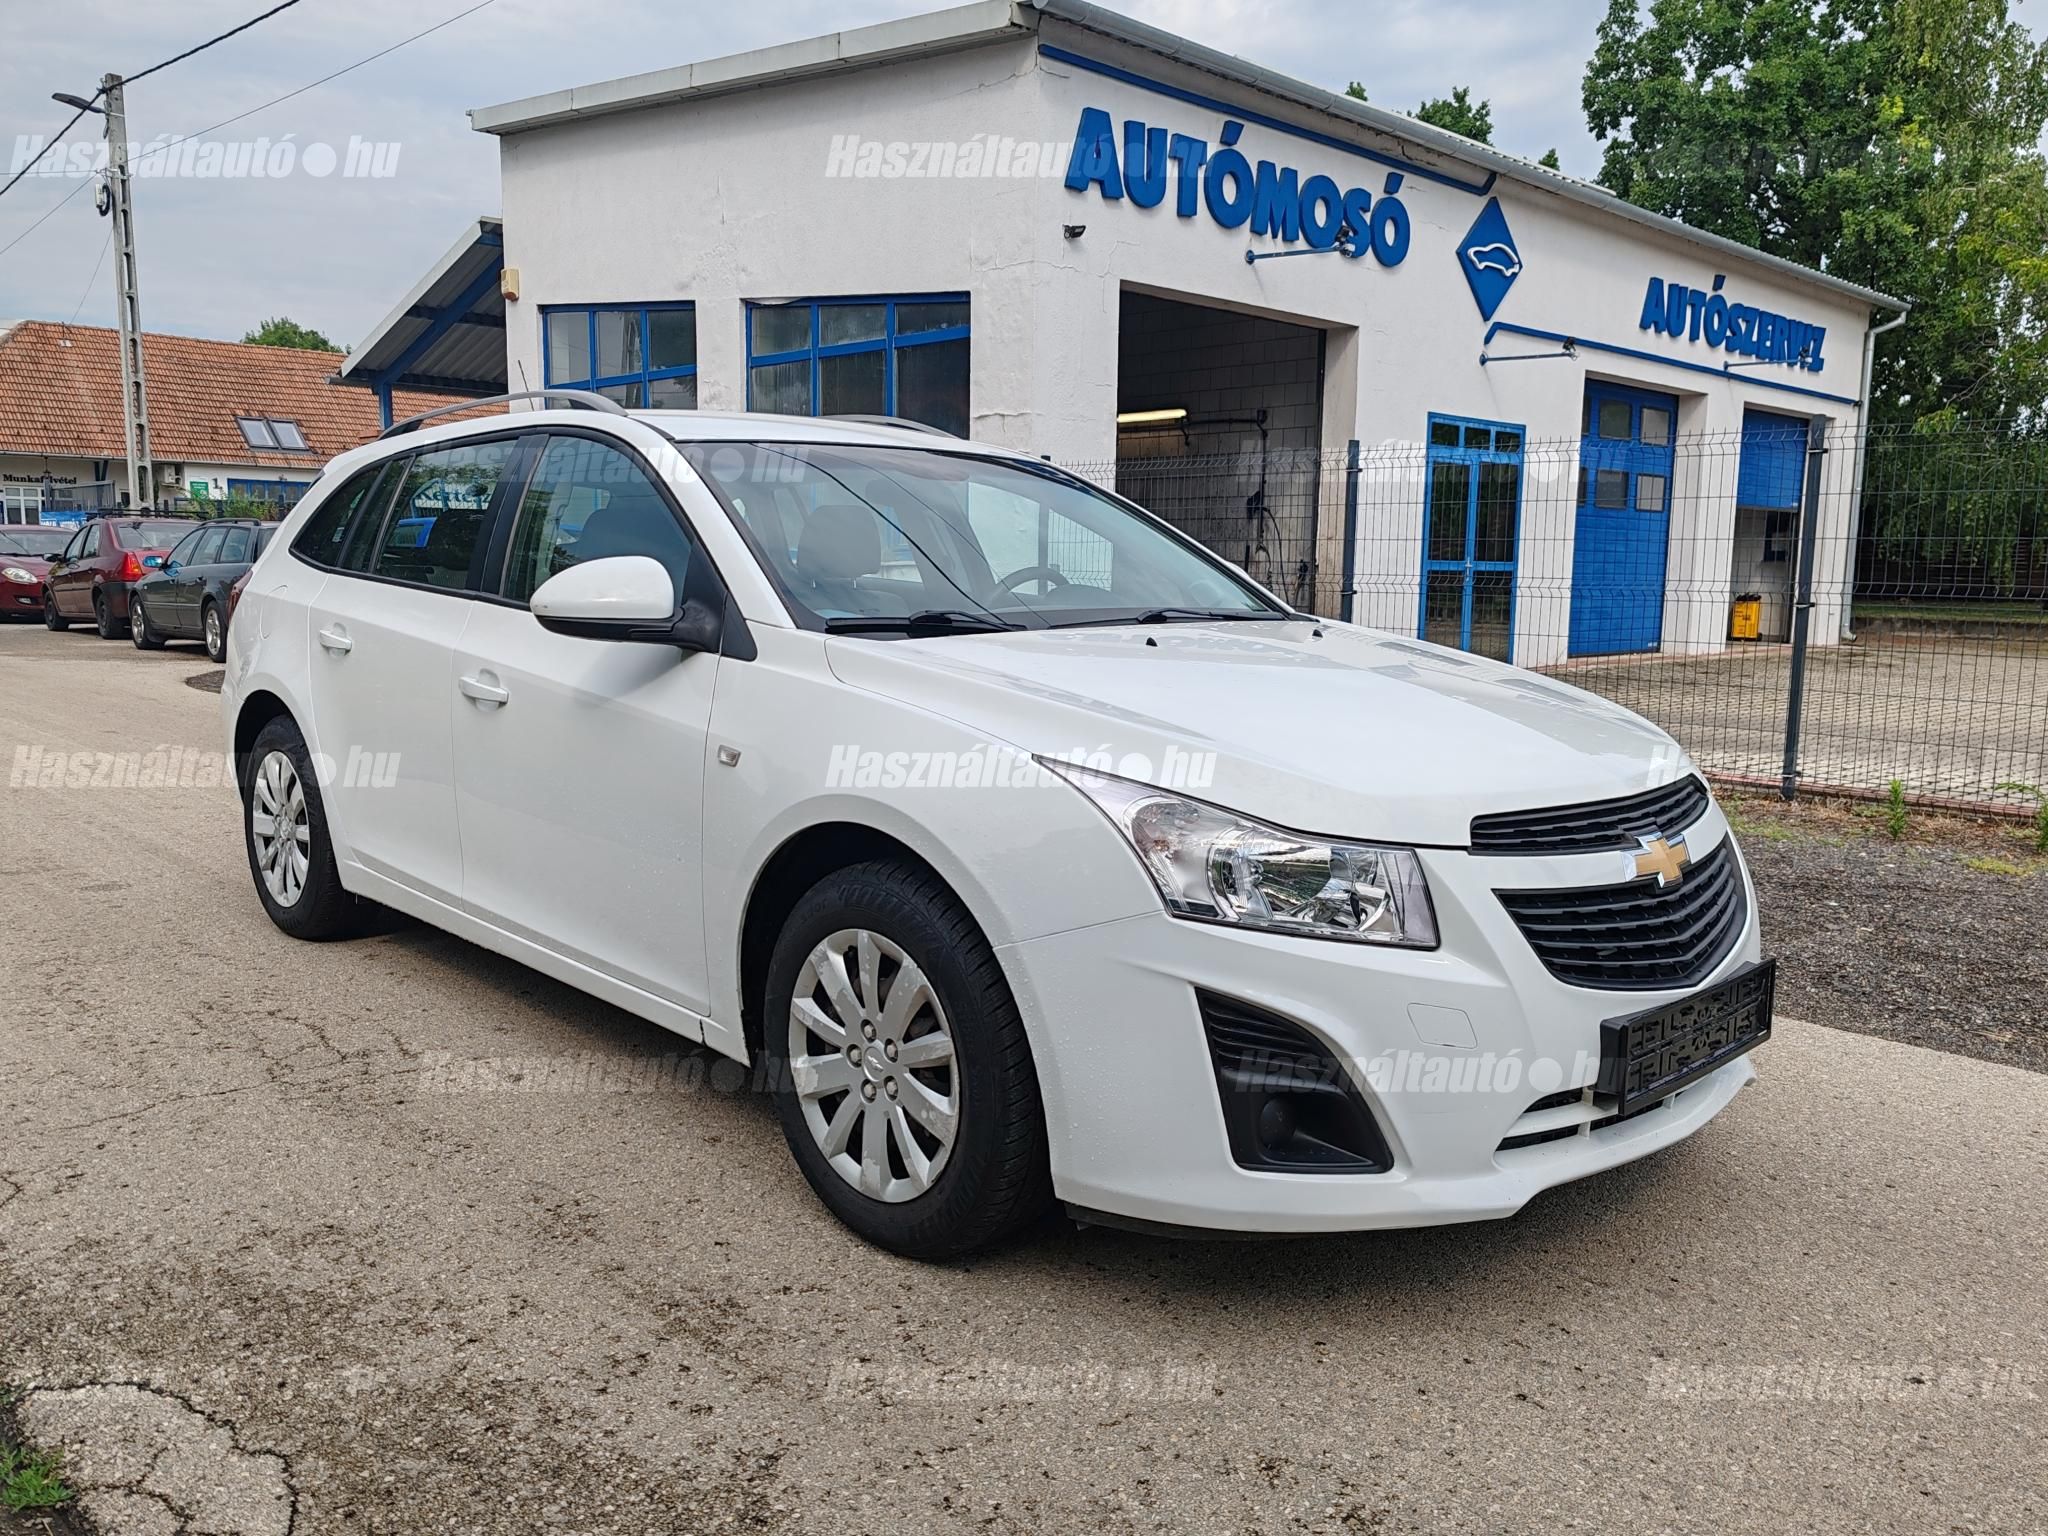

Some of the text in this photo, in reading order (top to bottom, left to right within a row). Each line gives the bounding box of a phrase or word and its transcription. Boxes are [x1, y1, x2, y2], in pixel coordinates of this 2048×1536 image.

[1064, 106, 1411, 268] AUTÓMOSÓ
[1639, 274, 1827, 373] AUTÓSZERVIZ
[2, 474, 77, 485] Munkaflvétel
